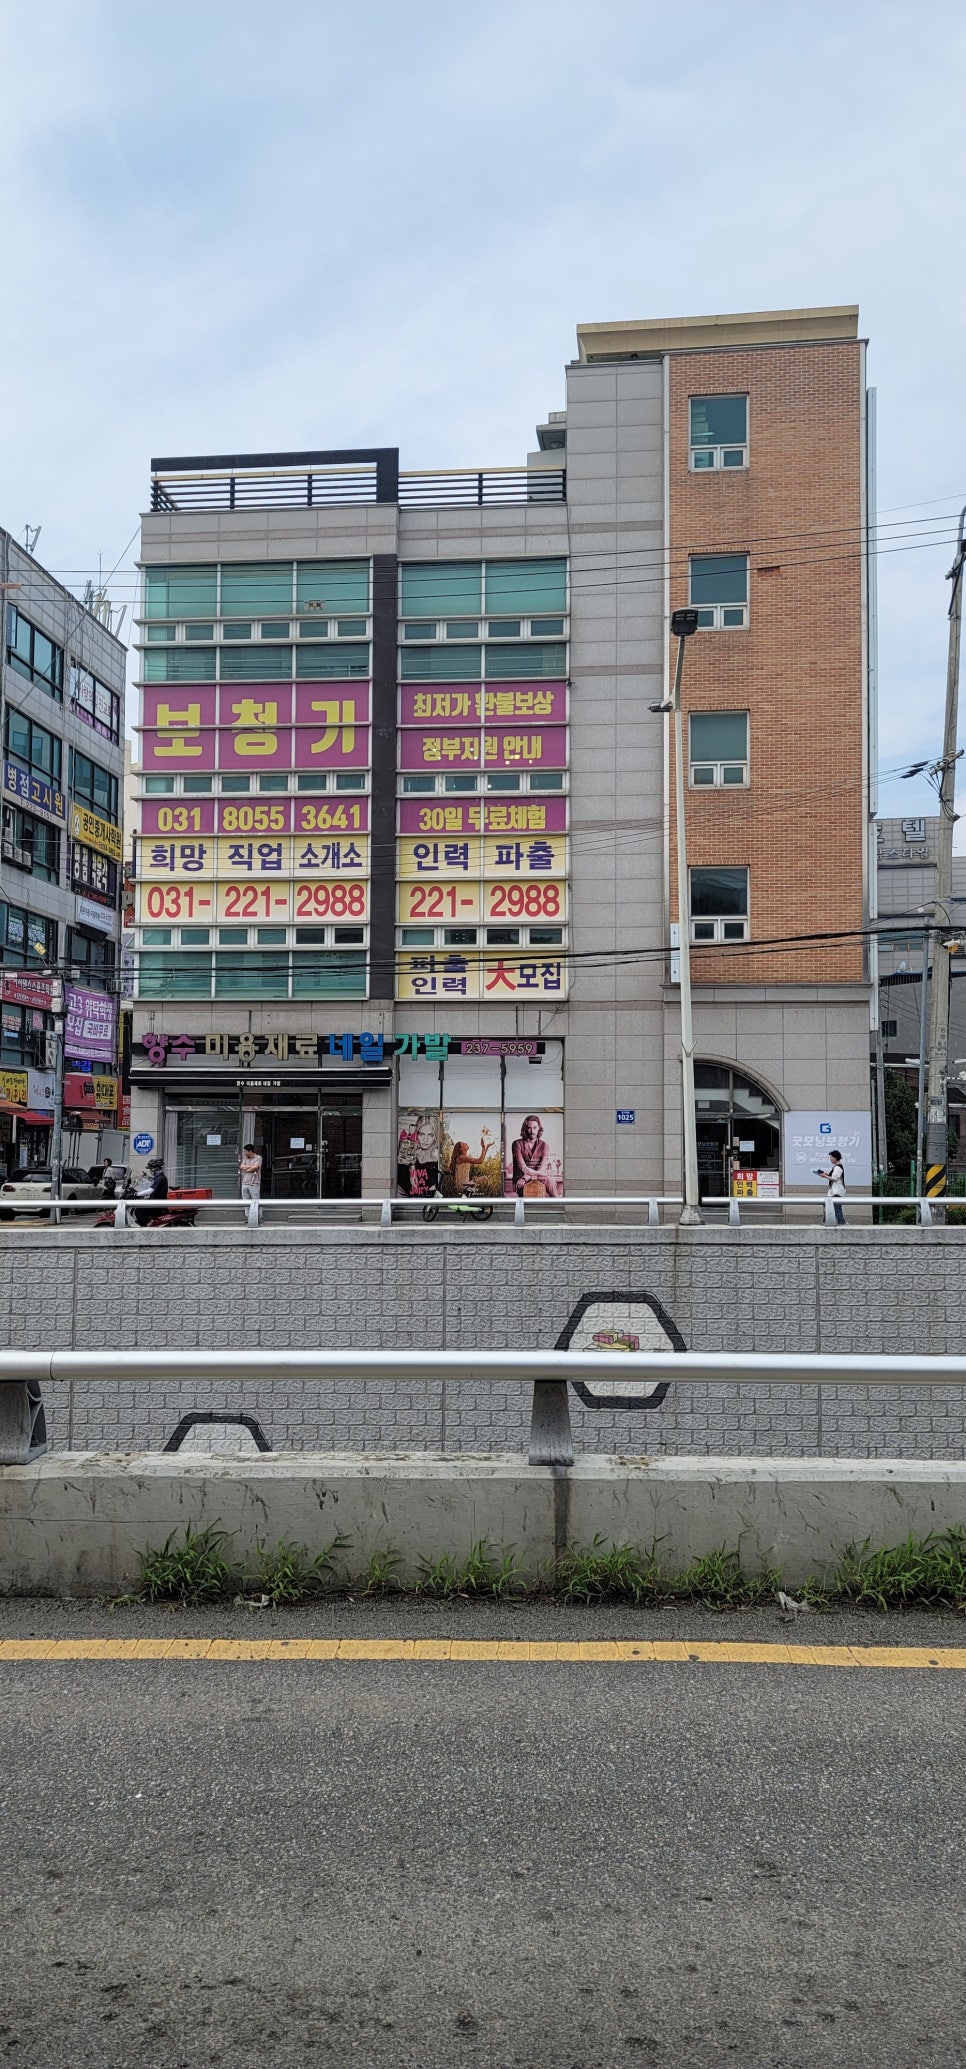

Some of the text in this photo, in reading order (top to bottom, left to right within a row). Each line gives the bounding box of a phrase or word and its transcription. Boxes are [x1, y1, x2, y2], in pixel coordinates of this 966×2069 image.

[413, 691, 554, 717] 최저가 환불보상
[422, 735, 542, 761] 정부지원 안내
[8, 765, 63, 817] 병점고시원
[157, 804, 361, 832] 031 8055 3641
[419, 804, 546, 831] 30일 무료체험
[149, 843, 207, 872] 희망
[228, 842, 282, 871] 직업
[299, 841, 362, 869] 소개소
[413, 841, 554, 871] 인력 파출
[296, 883, 365, 917] 2988
[490, 884, 560, 917] 2988
[410, 955, 469, 973] 파출
[411, 976, 467, 995] 인력
[68, 994, 83, 1014] 고3
[67, 1013, 109, 1037] 모집 국비무료
[142, 1032, 196, 1064] 향수
[205, 1032, 318, 1063] 미용재료
[329, 1032, 384, 1062] 네일
[393, 1032, 452, 1062] 가발
[465, 1042, 534, 1055] 237-5959
[137, 1139, 151, 1148] ADT
[791, 1135, 860, 1148] 굿모닝보청기
[409, 1168, 428, 1180] VIVA
[736, 1172, 754, 1181] 희망
